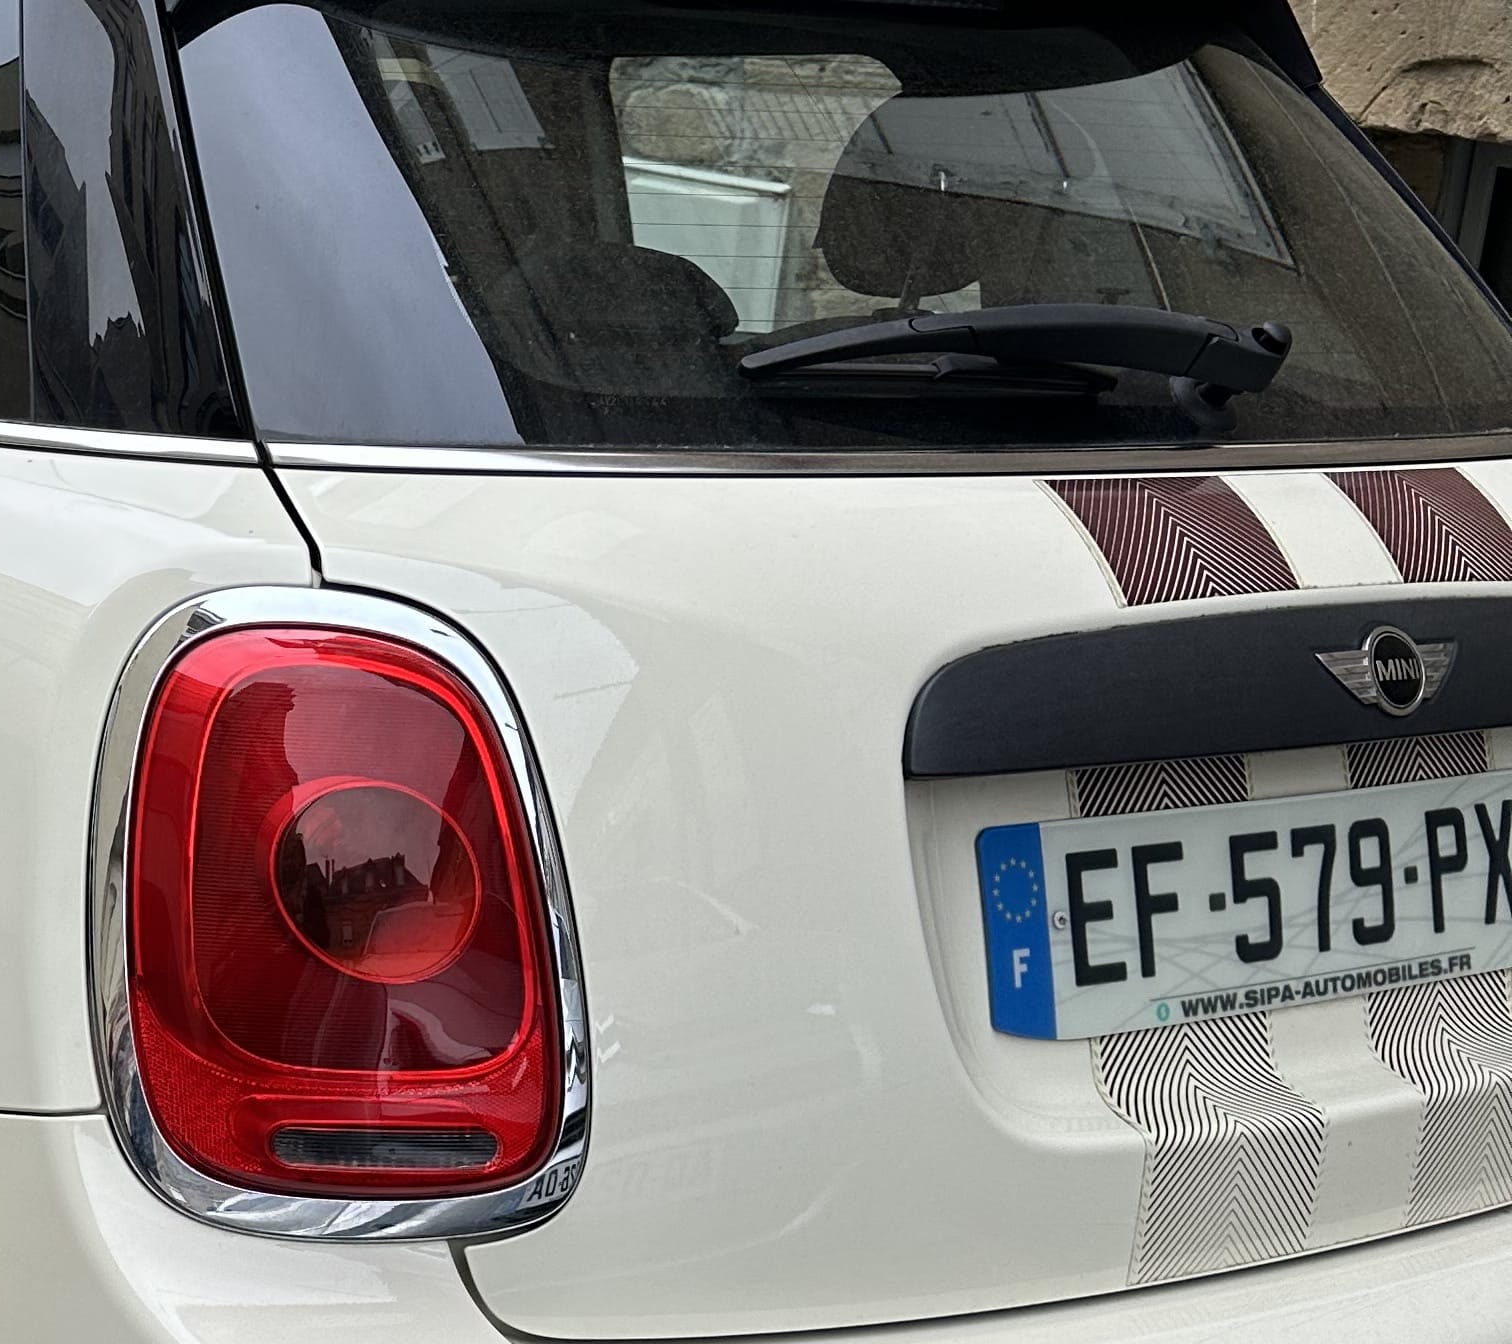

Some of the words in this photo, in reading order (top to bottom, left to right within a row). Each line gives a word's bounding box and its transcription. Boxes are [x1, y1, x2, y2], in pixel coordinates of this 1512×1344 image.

[1376, 657, 1420, 682] MINI
[1013, 948, 1030, 989] F
[1180, 953, 1472, 1018] WWW.SIPA-AUTOMOBILES.FR
